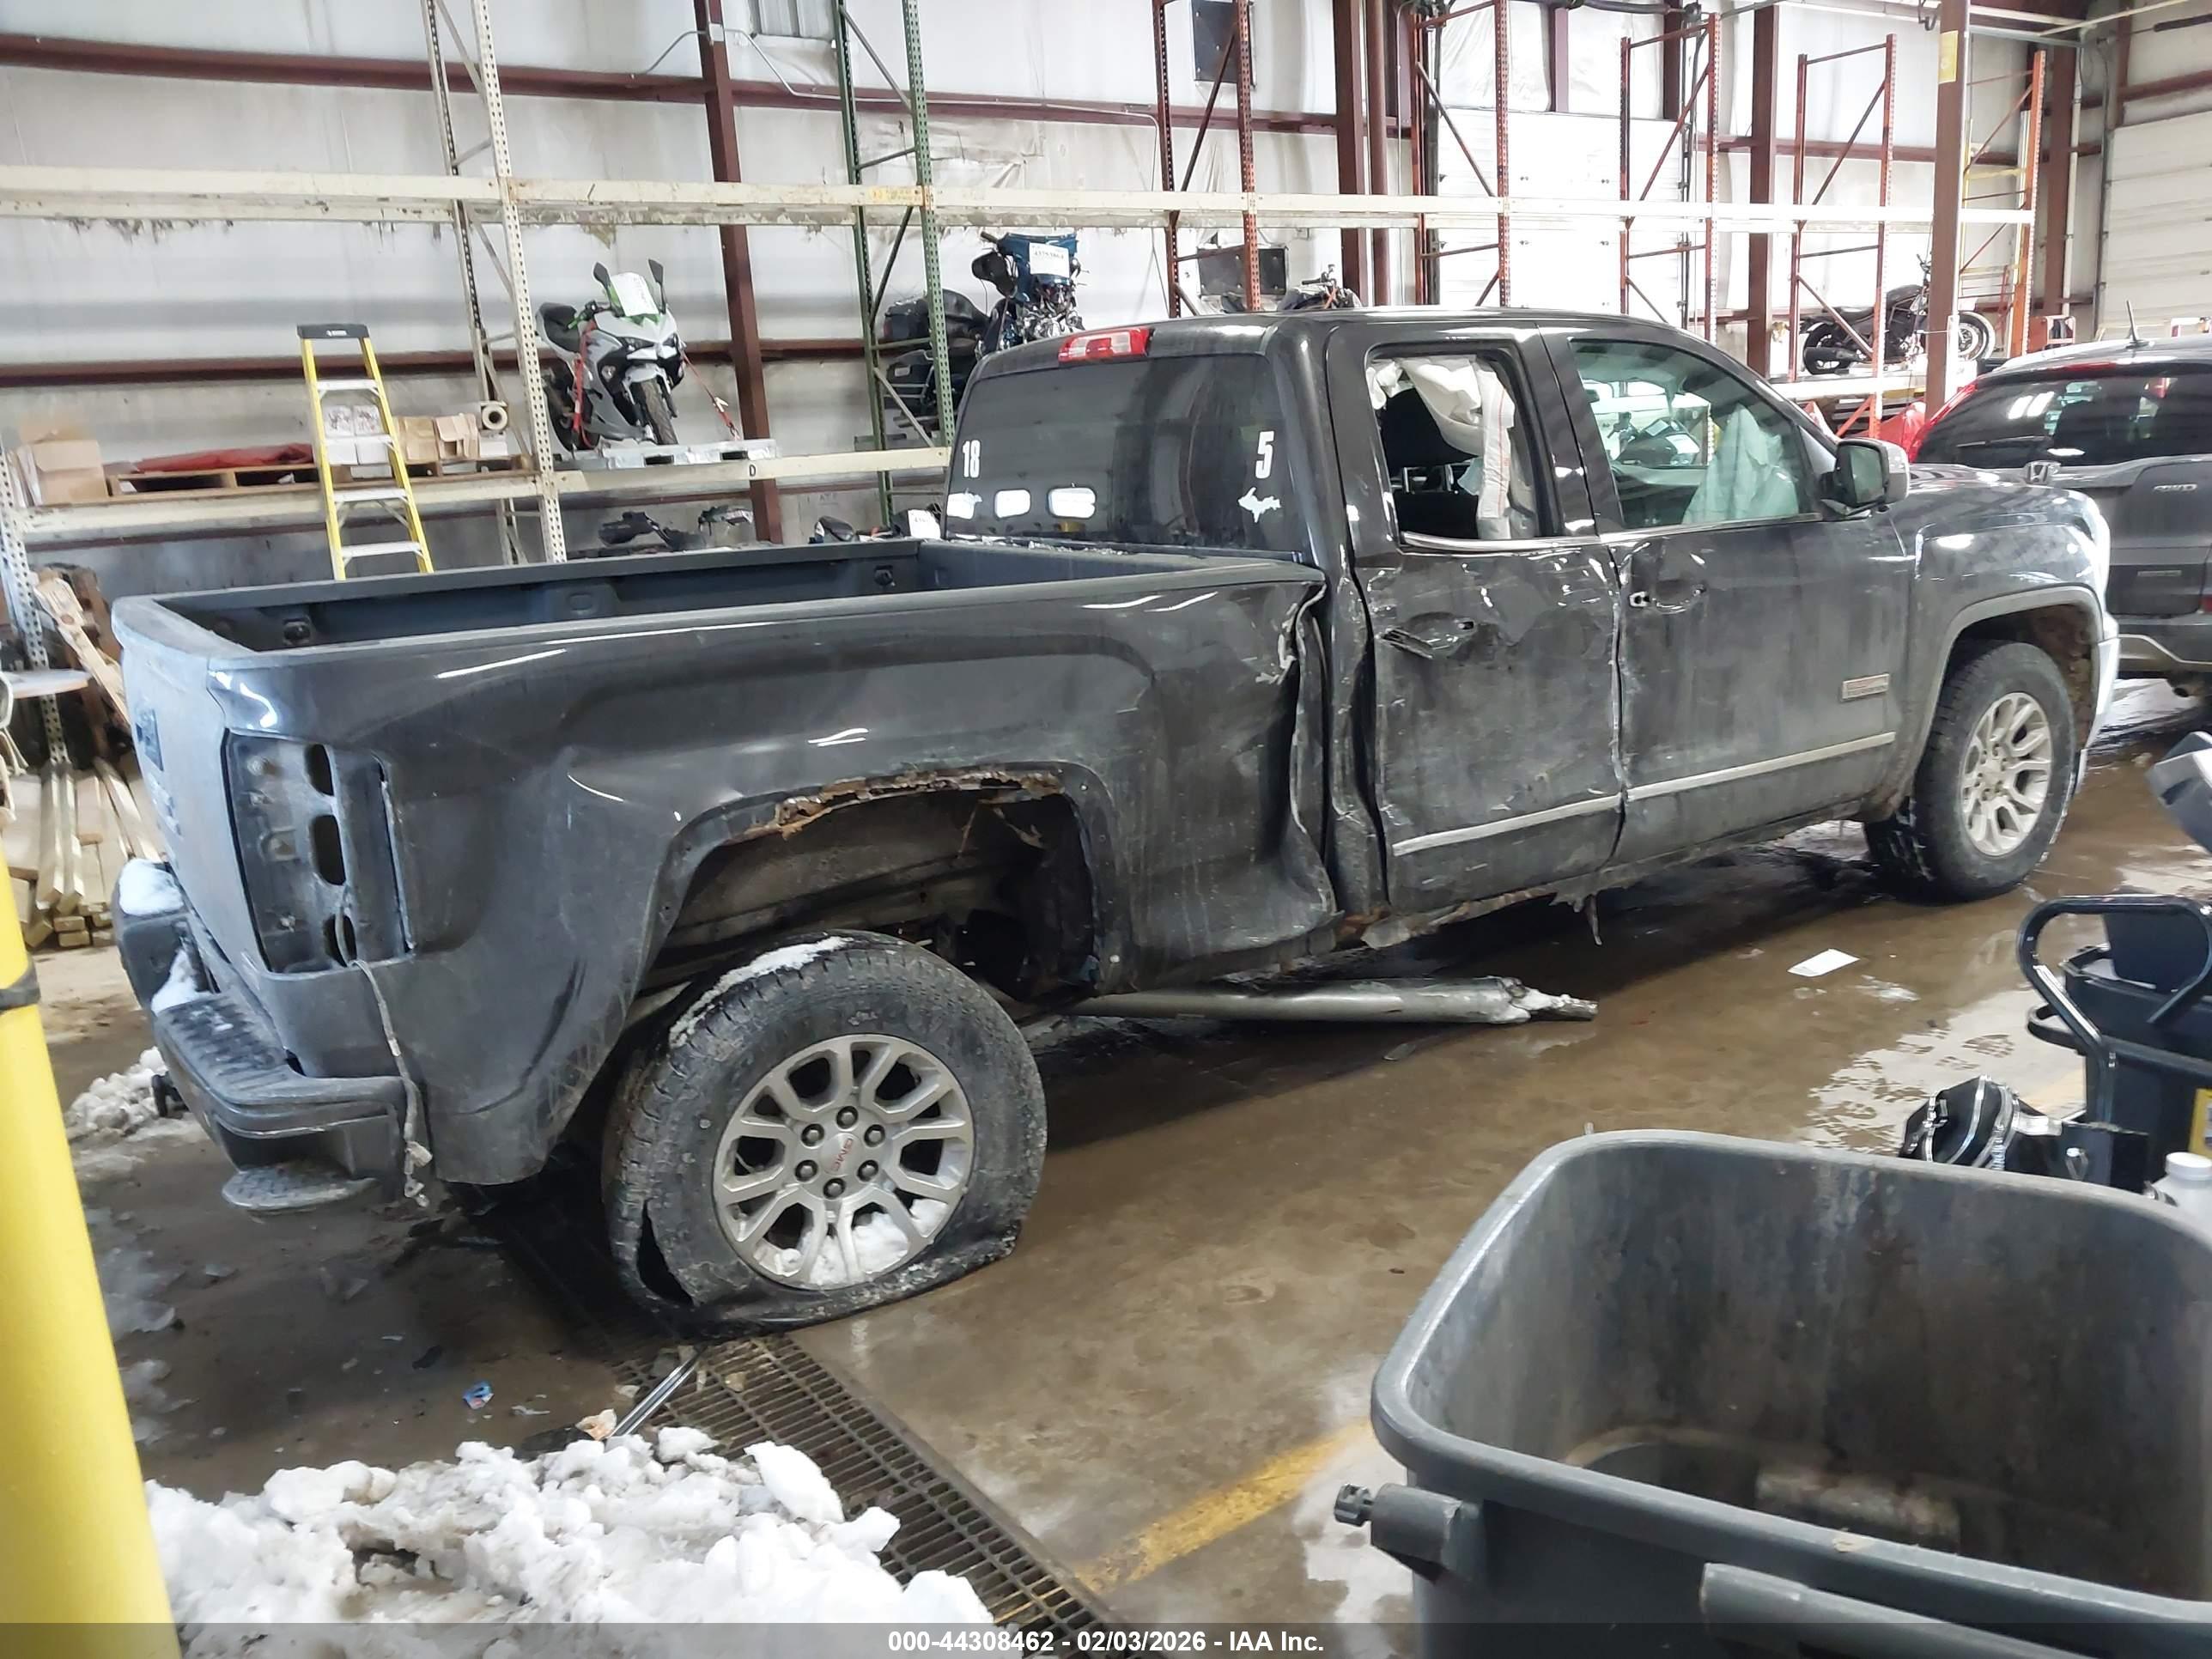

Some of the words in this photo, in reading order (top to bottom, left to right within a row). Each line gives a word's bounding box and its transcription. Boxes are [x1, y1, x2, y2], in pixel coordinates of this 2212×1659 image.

[749, 464, 757, 477] D
[963, 440, 981, 477] 18
[1255, 431, 1275, 478] 5
[831, 1138, 854, 1172] GMC
